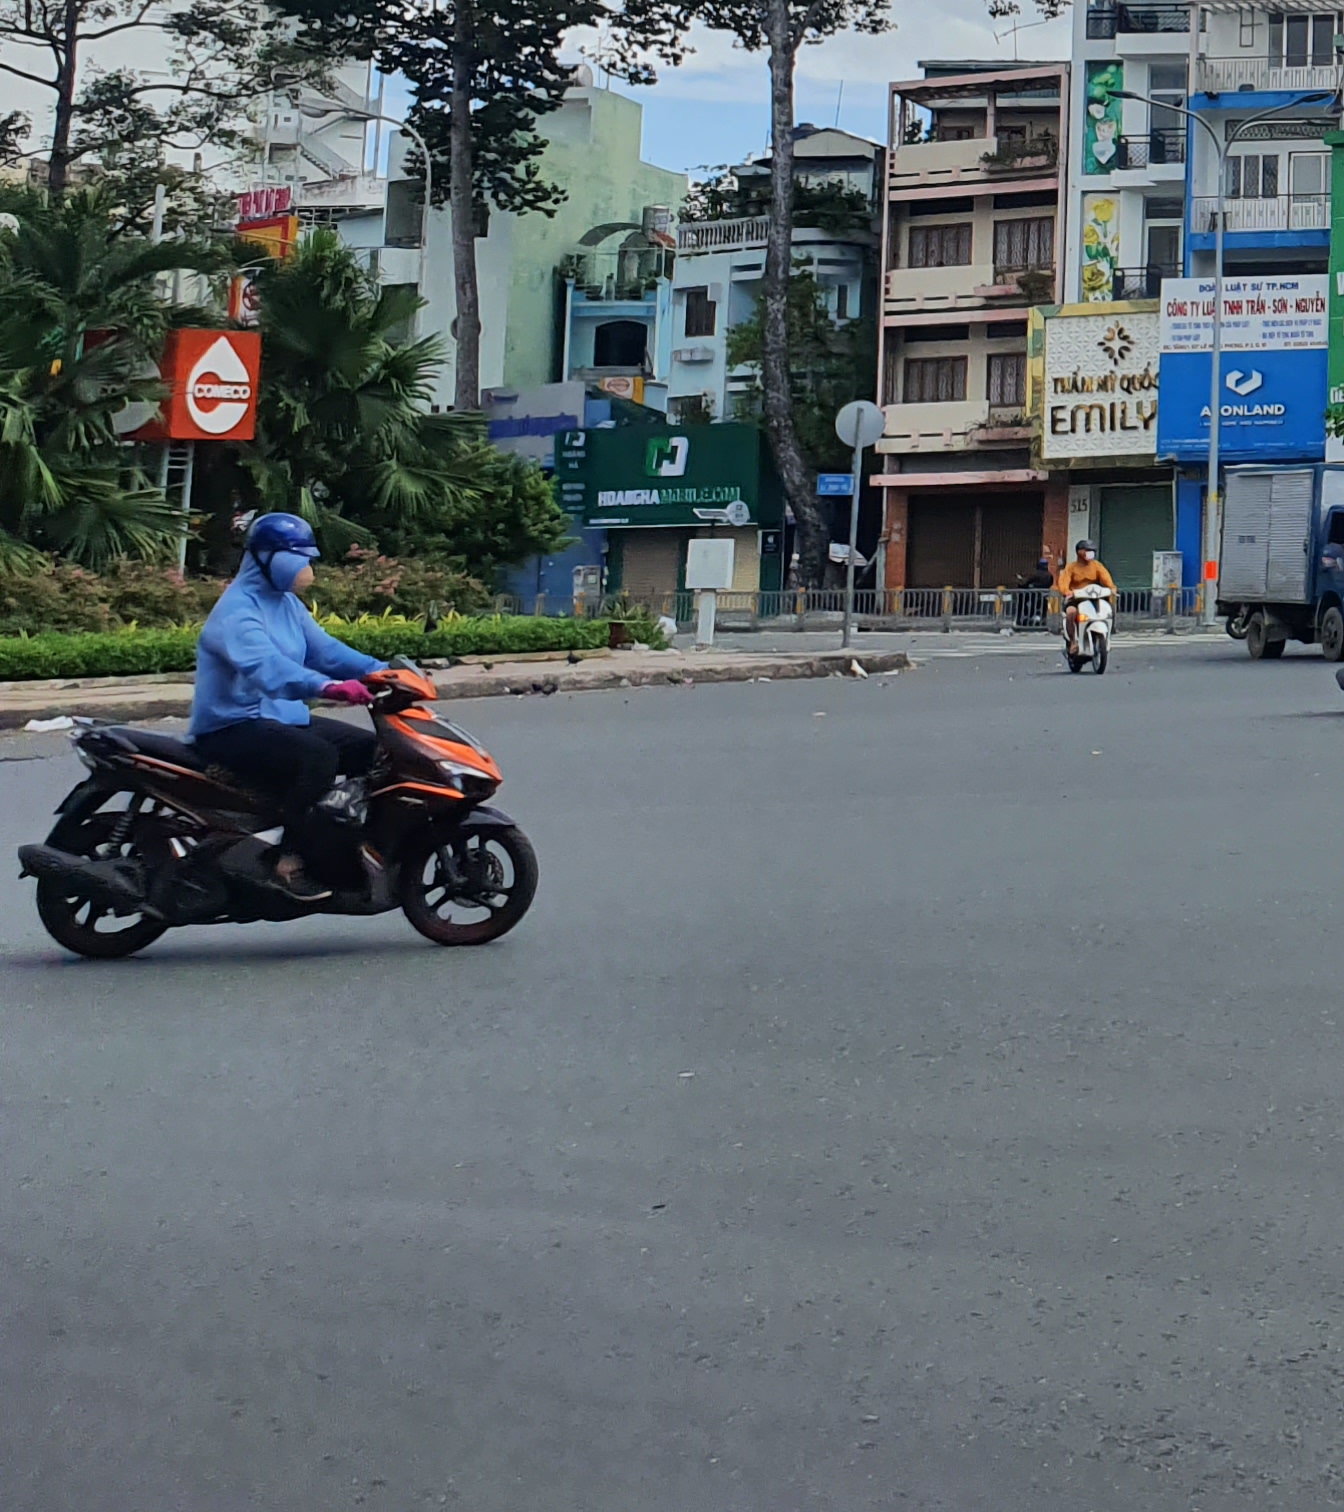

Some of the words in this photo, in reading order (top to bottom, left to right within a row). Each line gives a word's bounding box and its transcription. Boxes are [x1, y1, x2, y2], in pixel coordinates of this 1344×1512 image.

[1266, 282, 1299, 291] TP.HCM
[1166, 298, 1188, 317] CÔNG
[1190, 302, 1200, 317] TY
[1223, 300, 1243, 316] TNHH
[1272, 296, 1288, 314] SƠN
[1295, 291, 1326, 313] NGUYỄN
[194, 383, 251, 400] COMECO
[1051, 400, 1157, 435] EMILY
[1200, 403, 1285, 417] AONLAND
